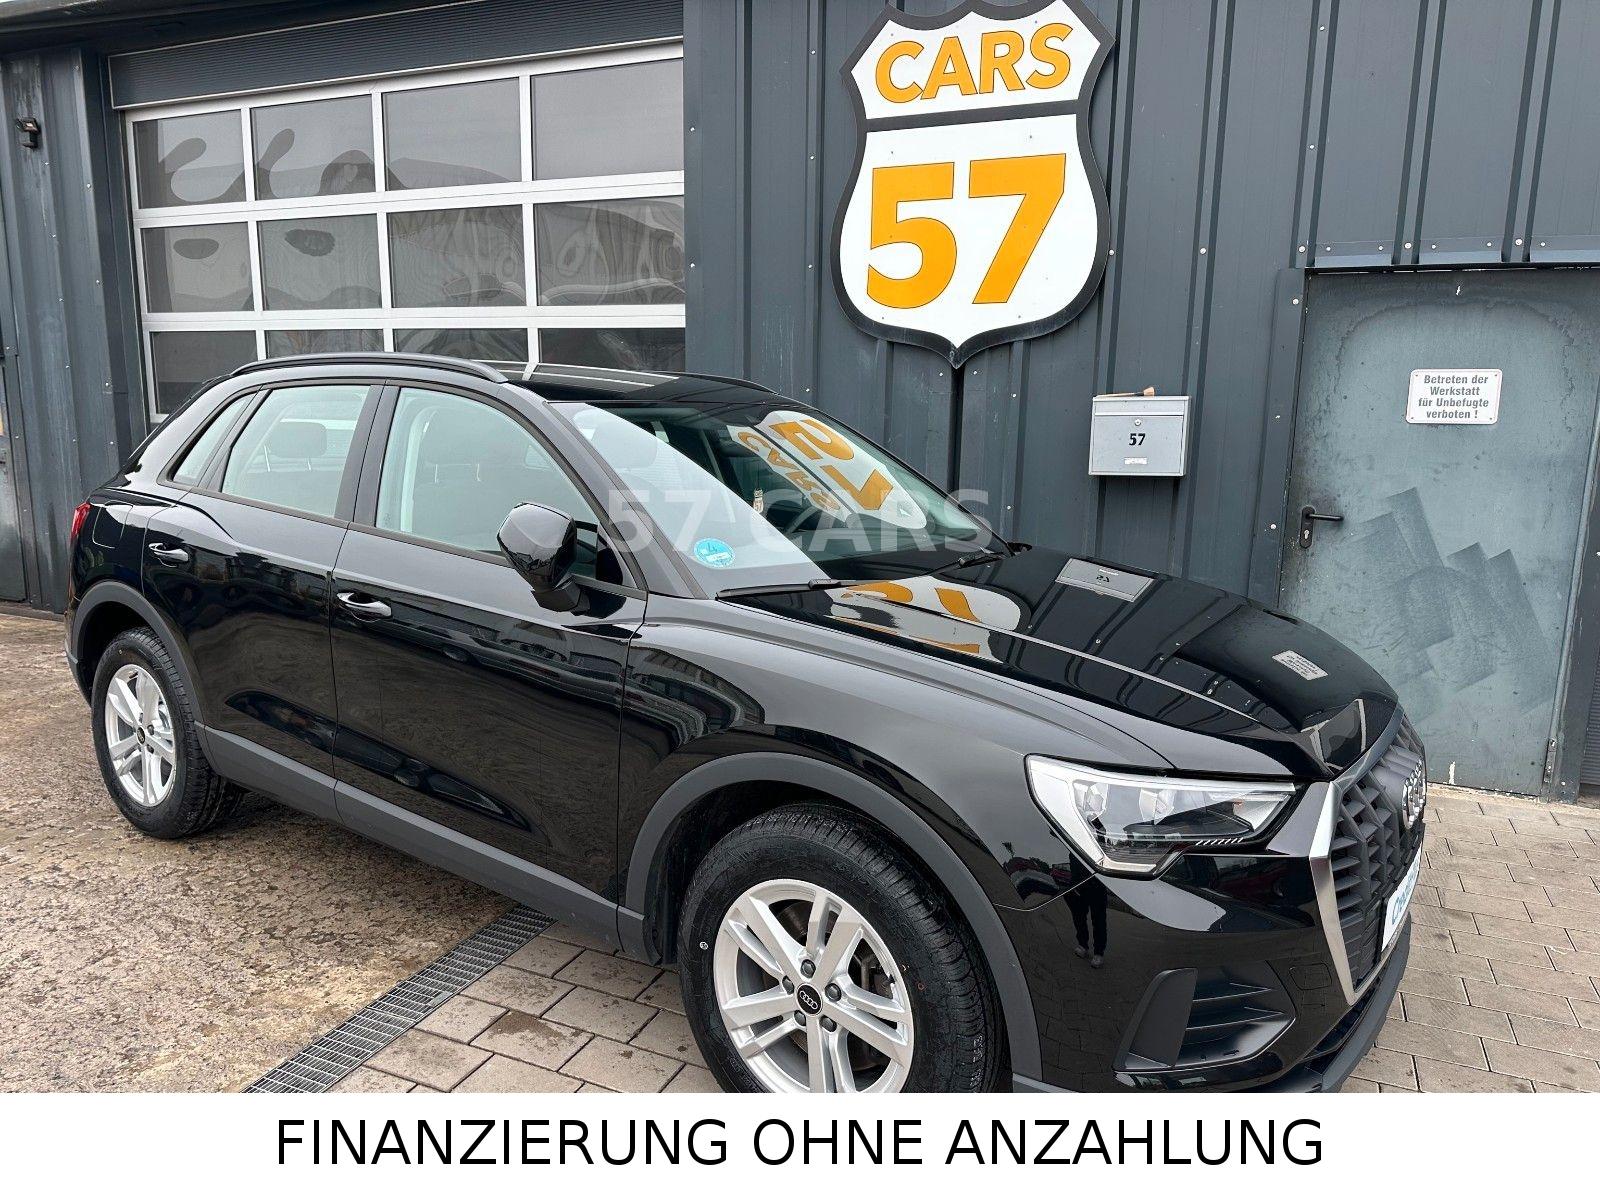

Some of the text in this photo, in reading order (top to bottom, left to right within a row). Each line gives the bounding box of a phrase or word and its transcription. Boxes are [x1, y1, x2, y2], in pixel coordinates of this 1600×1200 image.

[875, 22, 1074, 104] CARS
[866, 153, 1067, 309] 57
[1424, 374, 1489, 384] Betreten der
[1430, 386, 1480, 396] Werkstatt
[1418, 397, 1489, 409] für Unbefugte
[1426, 409, 1478, 419] verboten !
[1129, 433, 1146, 446] 57
